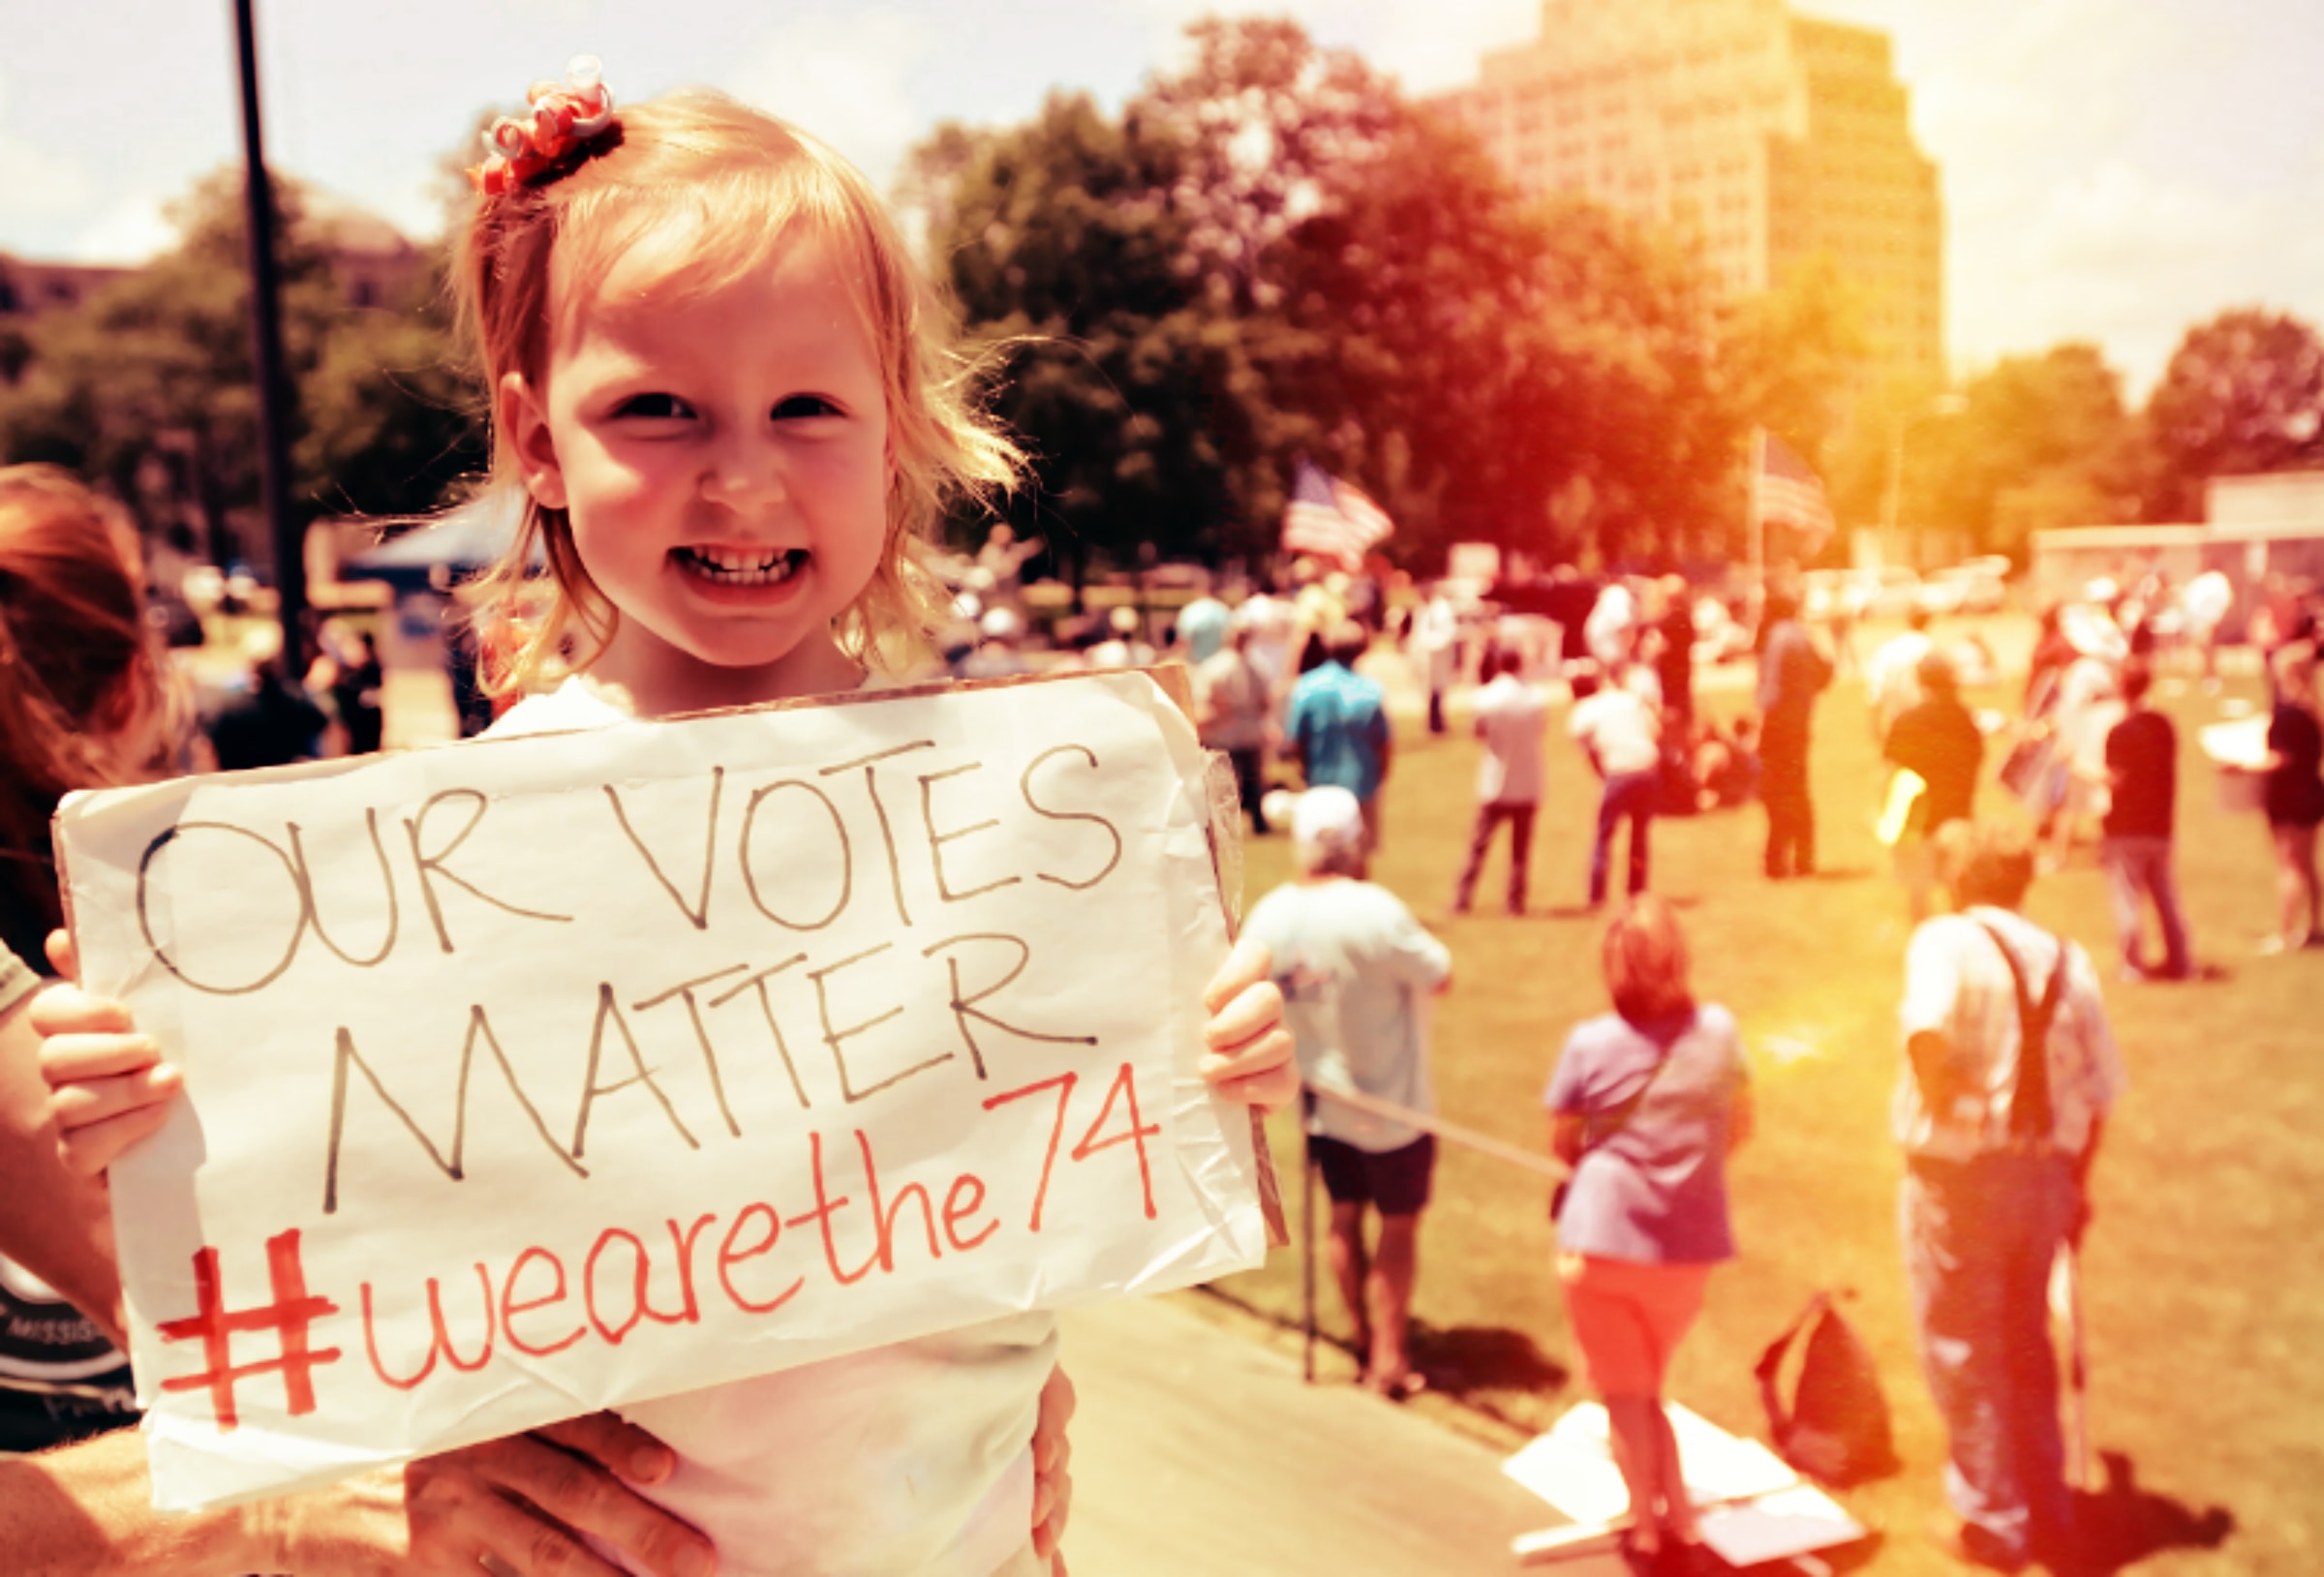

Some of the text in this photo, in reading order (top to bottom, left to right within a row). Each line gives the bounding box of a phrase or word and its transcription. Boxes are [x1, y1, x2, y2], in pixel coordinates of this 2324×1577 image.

[137, 740, 1121, 996] OUR VOTES
[322, 933, 1098, 1215] MATTER
